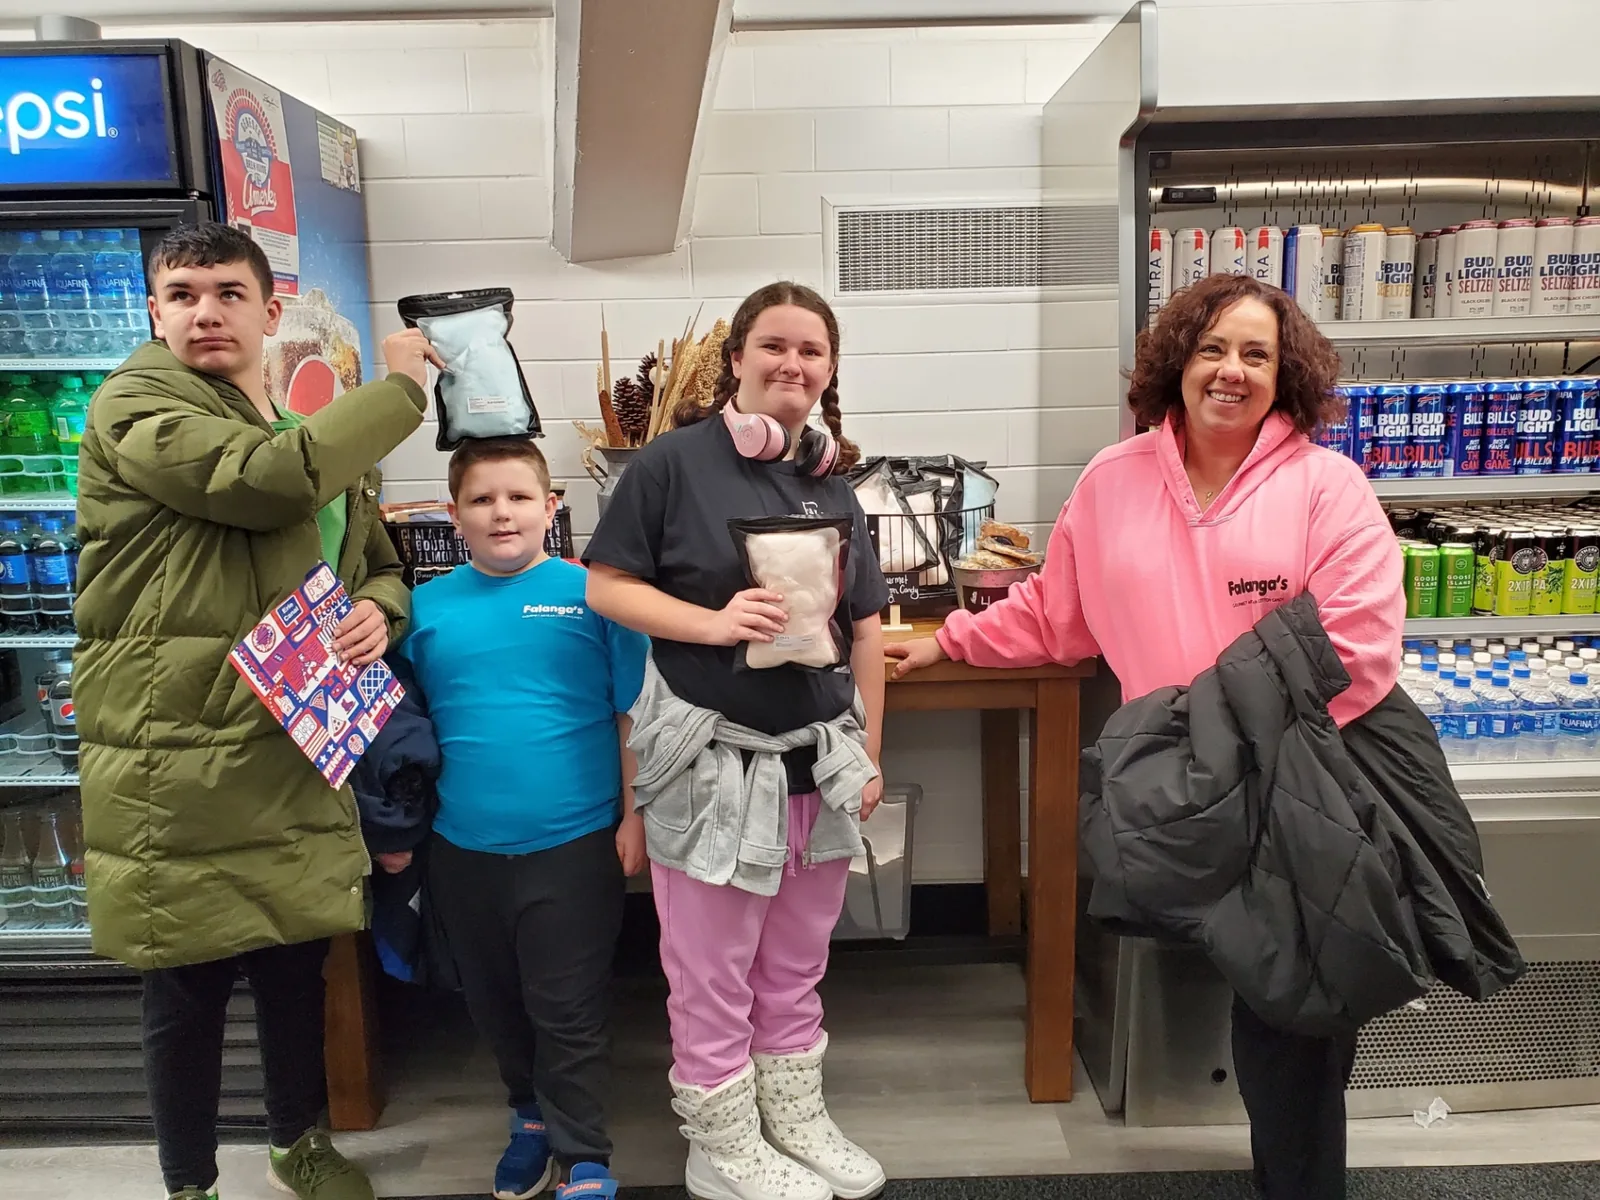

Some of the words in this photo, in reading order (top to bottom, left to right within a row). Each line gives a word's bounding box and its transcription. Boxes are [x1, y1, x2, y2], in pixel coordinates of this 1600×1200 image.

[0, 77, 107, 155] psi
[1464, 256, 1494, 268] BUD
[1504, 255, 1533, 267] BUD
[1377, 413, 1408, 425] BUD
[1412, 412, 1444, 425] BUD
[1487, 411, 1516, 424] BILLS
[1519, 409, 1552, 421] BUD
[1573, 408, 1596, 420] BU
[1467, 451, 1480, 460] TH
[1490, 450, 1508, 460] THE
[1484, 460, 1512, 470] GAME
[886, 575, 908, 585] urmet
[1228, 574, 1288, 596] Falanga's
[523, 604, 584, 615] Falanga's
